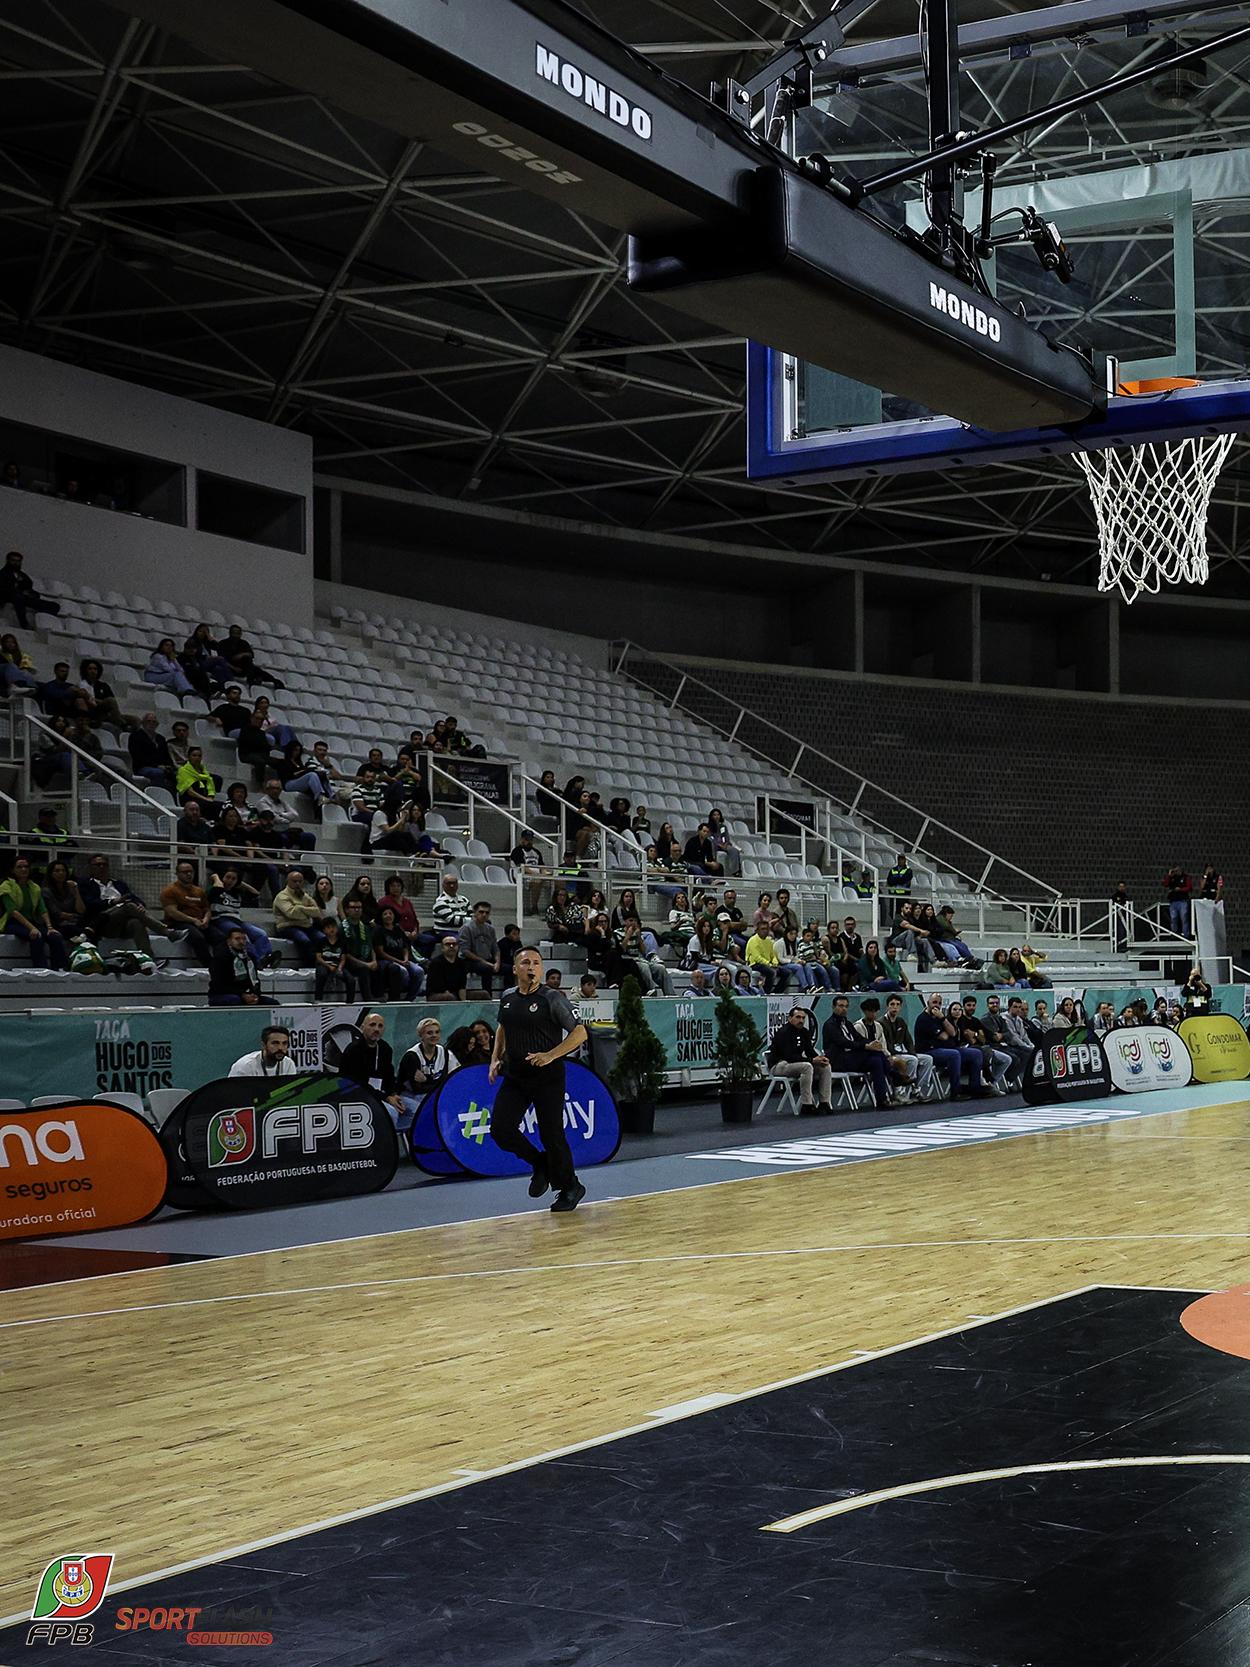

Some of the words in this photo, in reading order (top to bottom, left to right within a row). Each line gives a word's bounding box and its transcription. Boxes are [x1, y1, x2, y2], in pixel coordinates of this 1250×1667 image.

[536, 44, 653, 140] MONDO
[928, 281, 1001, 343] MONDO
[675, 1003, 695, 1019] TAÇA
[94, 1019, 131, 1042] TAÇA
[676, 1020, 702, 1040] HUGO
[96, 1041, 149, 1072] HUGO
[152, 1044, 172, 1060] DOS
[677, 1041, 715, 1062] SANTOS
[1067, 1042, 1103, 1076] FPB
[262, 1102, 375, 1159] FPB
[217, 1171, 265, 1188] FEDERAÇÃO
[266, 1165, 317, 1180] PORTUGUESA
[317, 1164, 328, 1174] DE
[328, 1159, 377, 1173] BASQUETEBOL
[5, 1176, 93, 1200] seguros
[56, 1207, 97, 1223] oficial
